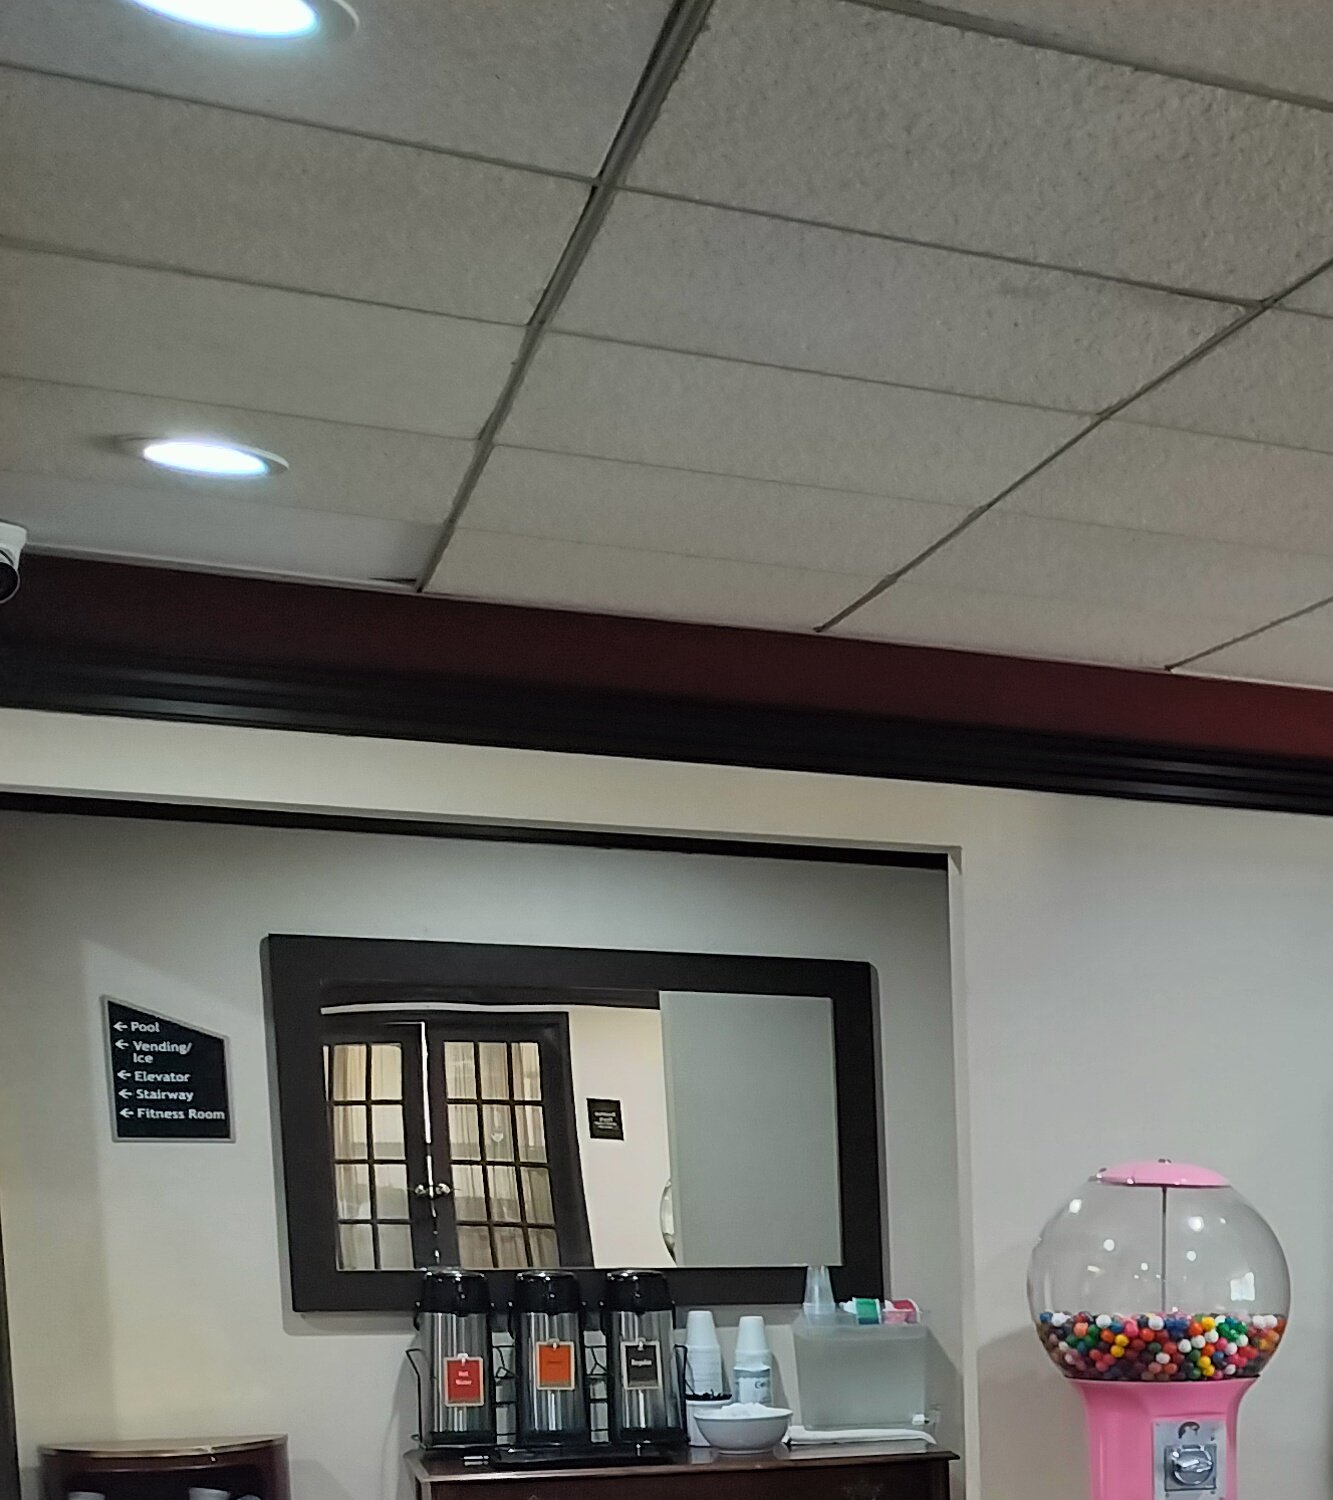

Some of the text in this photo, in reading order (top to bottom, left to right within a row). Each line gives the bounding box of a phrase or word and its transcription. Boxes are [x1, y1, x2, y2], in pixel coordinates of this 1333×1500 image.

[130, 1021, 160, 1032] Pool
[132, 1040, 192, 1055] Vending/
[133, 1053, 154, 1063] Ice
[134, 1071, 191, 1082] Elevator
[136, 1089, 194, 1102] Stairway
[137, 1108, 225, 1120] Fitness Room
